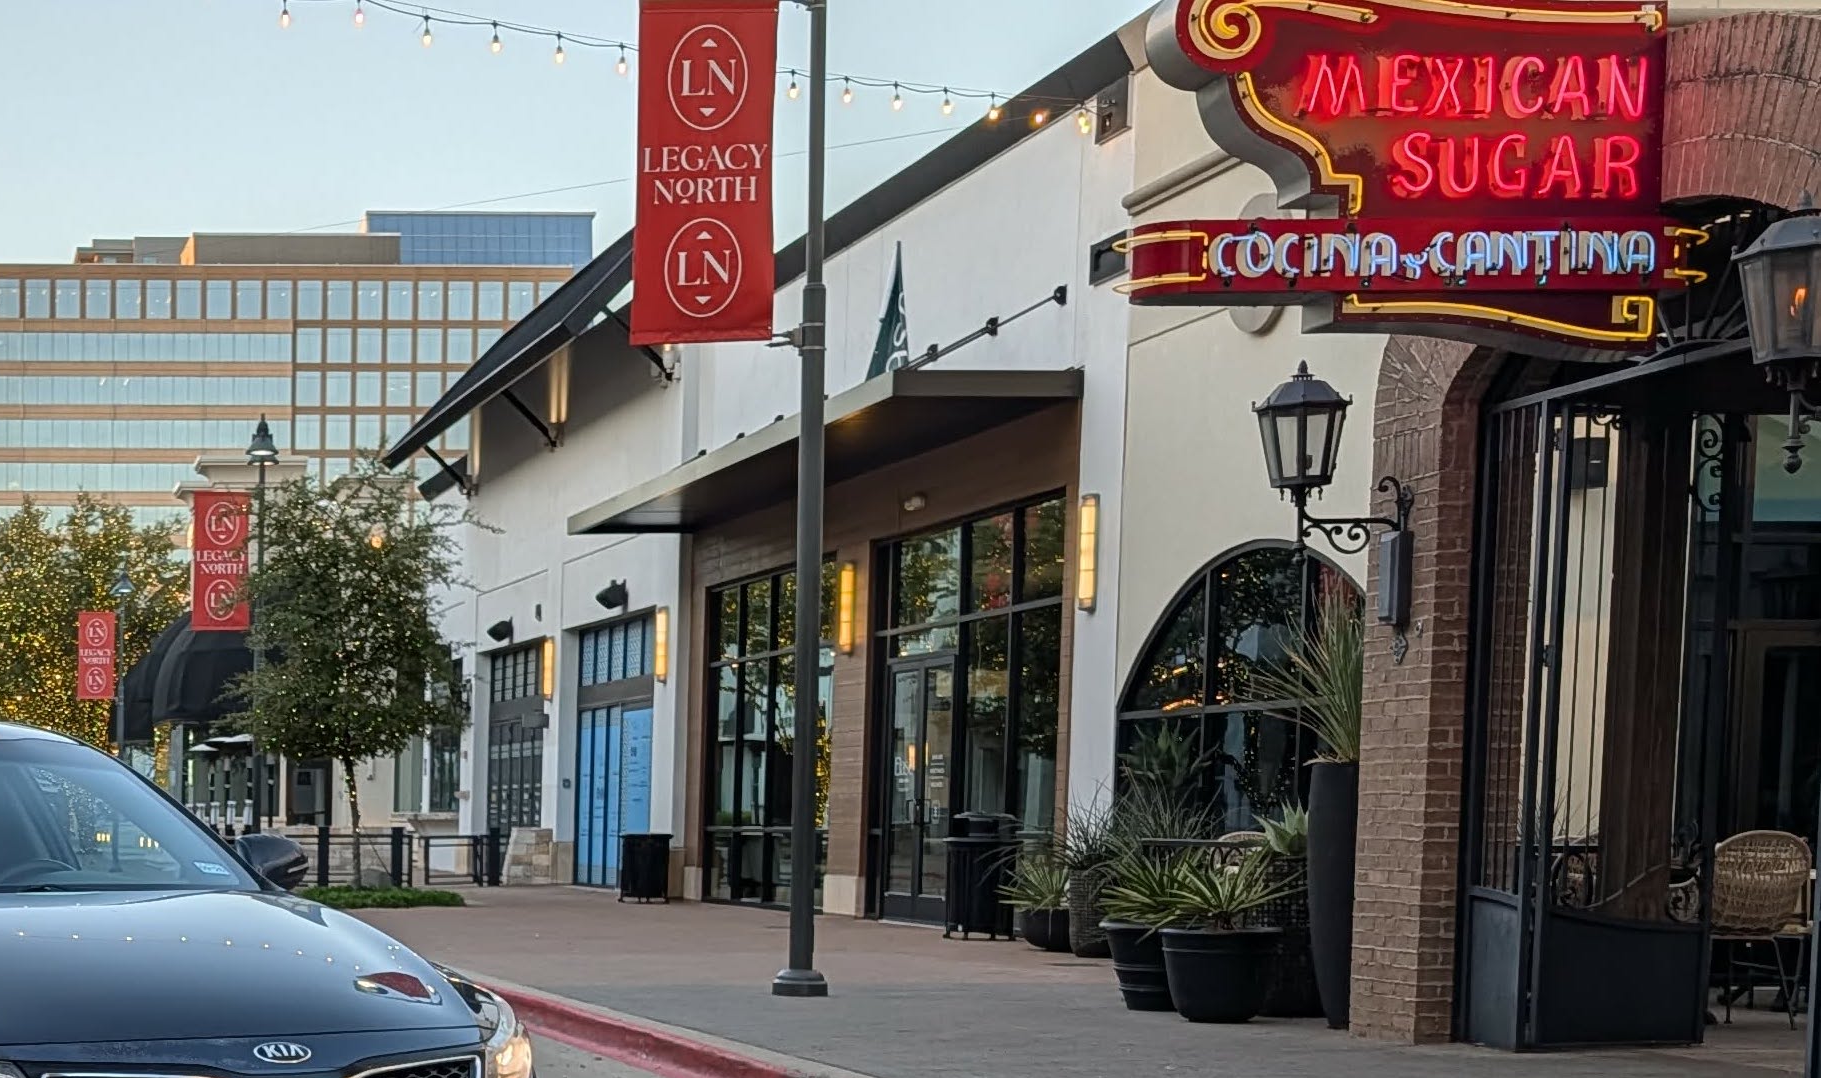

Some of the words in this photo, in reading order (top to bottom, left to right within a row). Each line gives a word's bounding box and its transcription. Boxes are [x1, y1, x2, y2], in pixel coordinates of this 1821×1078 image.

[682, 59, 737, 96] LN
[1293, 54, 1648, 119] MEXICAN
[643, 144, 768, 173] LEGACY
[1391, 132, 1640, 199] SUGAR
[653, 176, 757, 205] NORTH
[677, 249, 732, 286] LN
[1209, 231, 1398, 278] COCINA
[1429, 231, 1656, 277] CANTINA
[201, 563, 244, 575] NORTH
[262, 1043, 305, 1059] KIA
